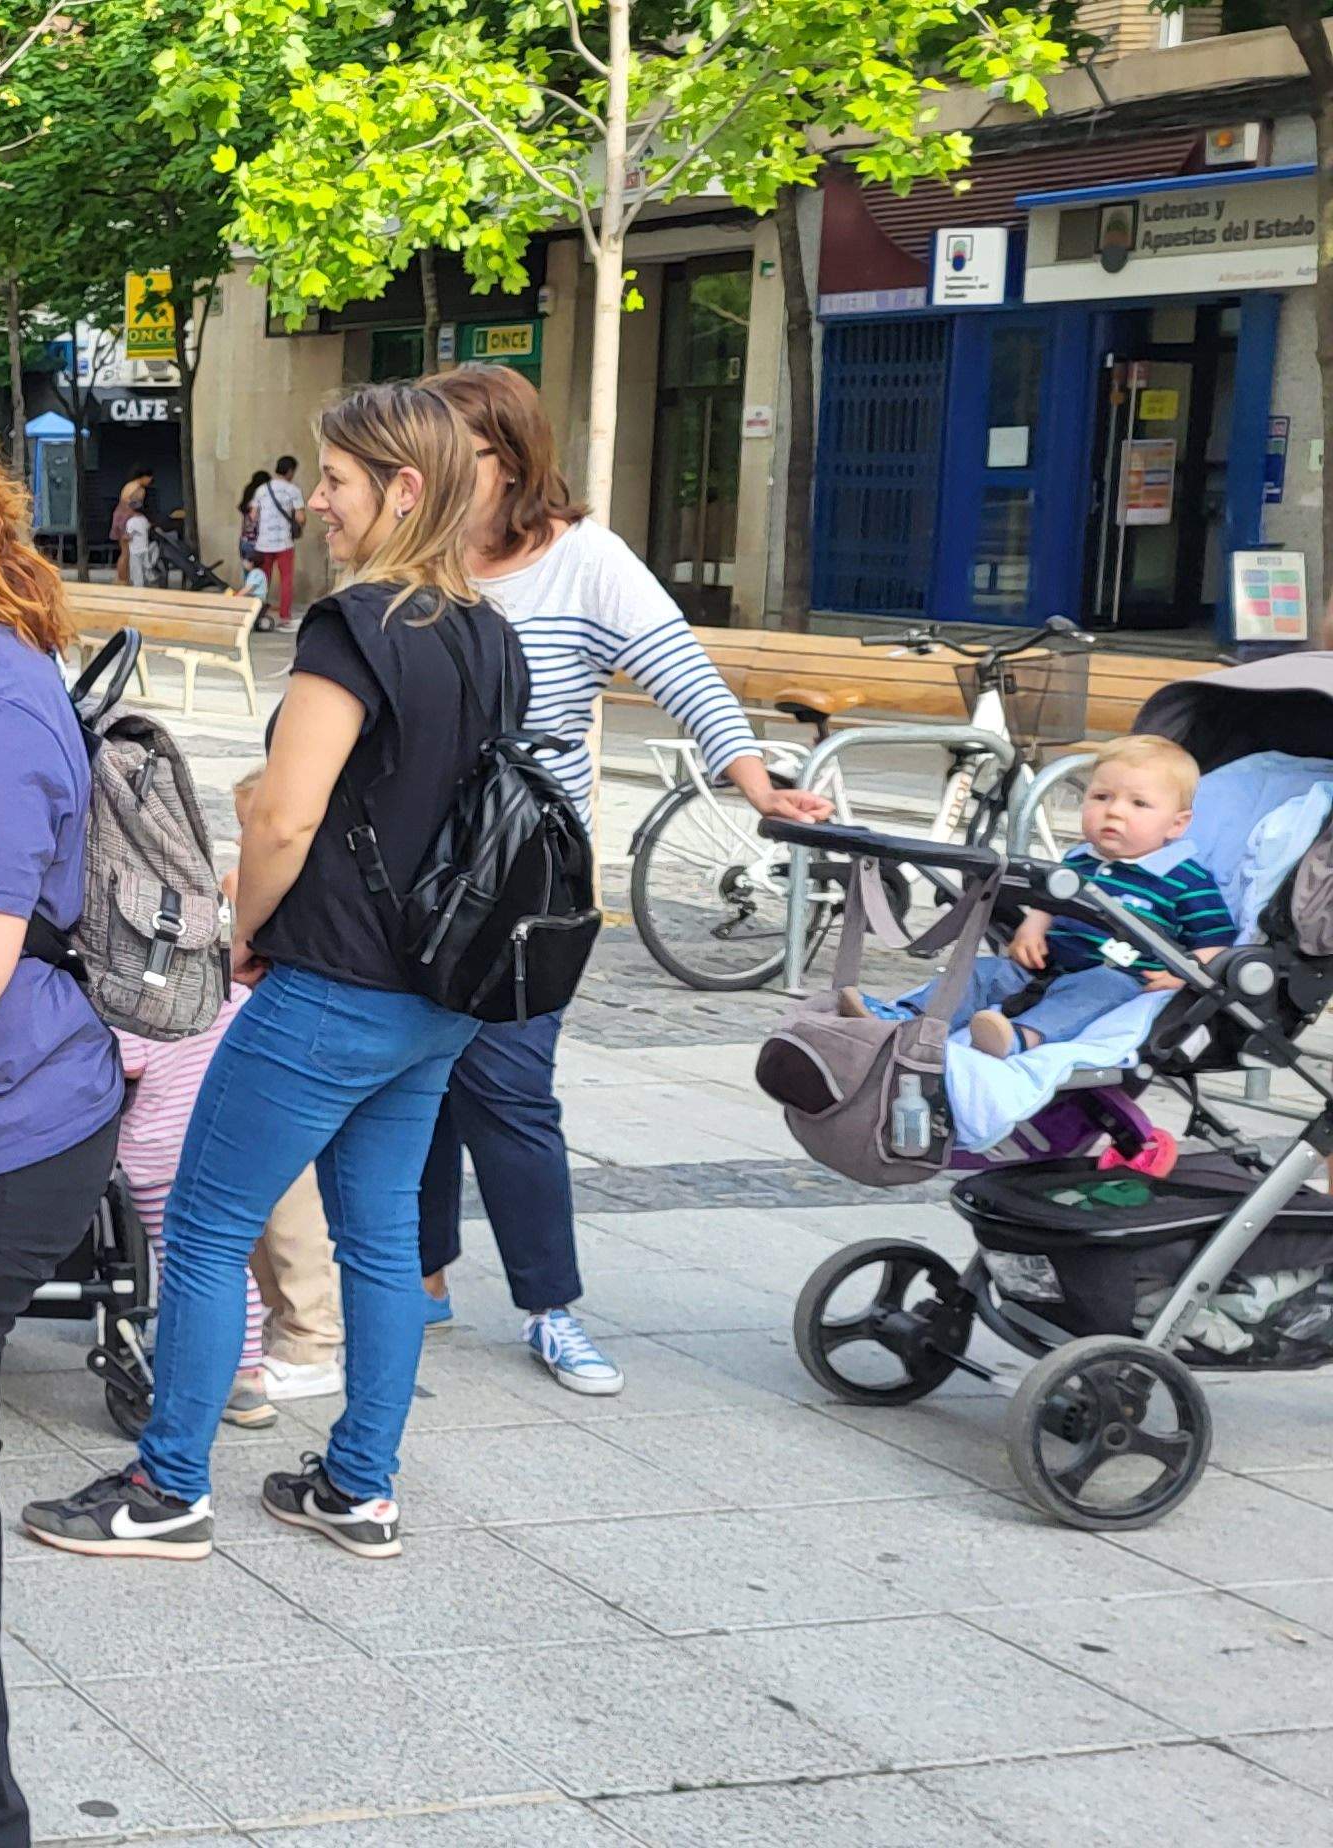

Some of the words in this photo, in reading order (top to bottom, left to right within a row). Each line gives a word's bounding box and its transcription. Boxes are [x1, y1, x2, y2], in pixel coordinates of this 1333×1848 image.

[1214, 200, 1226, 221] y
[1141, 227, 1216, 253] Apuestas
[1222, 220, 1249, 242] del
[1254, 214, 1316, 240] Estado
[491, 331, 528, 349] ONCE
[110, 398, 169, 422] CAFE
